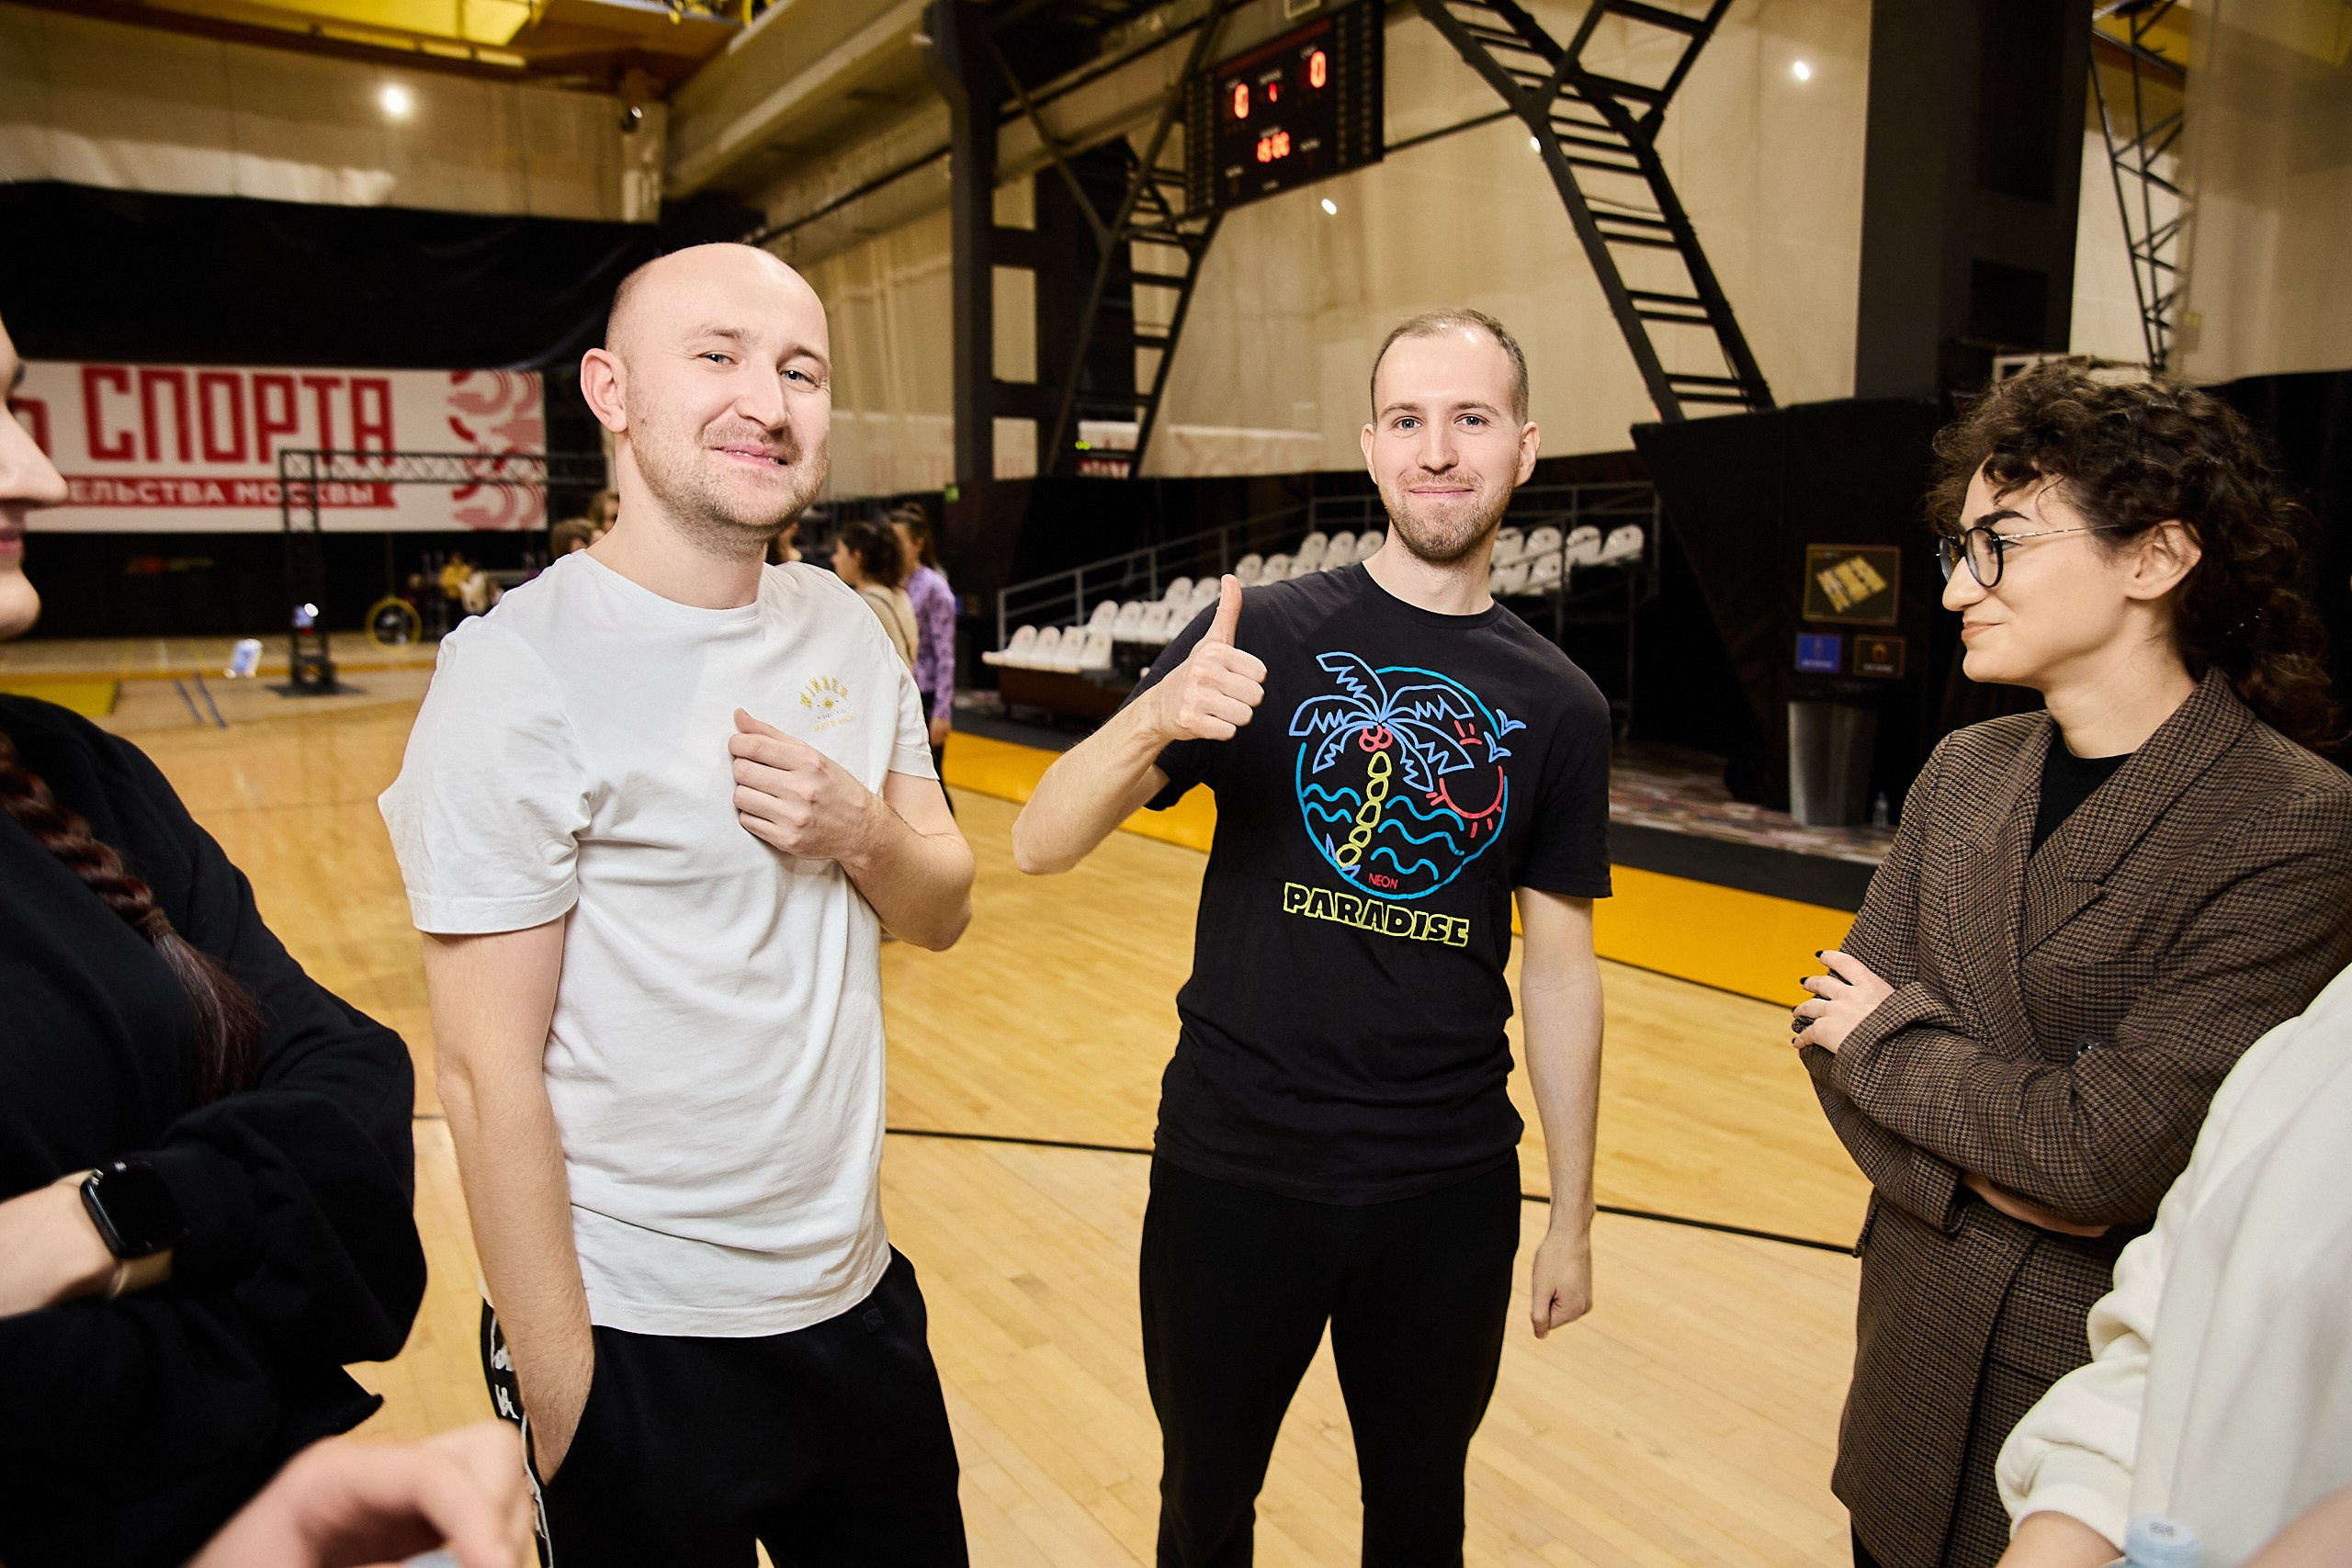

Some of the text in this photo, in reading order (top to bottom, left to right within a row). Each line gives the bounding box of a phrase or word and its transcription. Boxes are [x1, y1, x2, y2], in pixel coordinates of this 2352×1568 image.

[81, 365, 394, 467] СПОРТА
[69, 479, 227, 503] ЕЛЬСТВА
[1369, 873, 1398, 889] NEON
[1283, 882, 1469, 947] PARADISE
